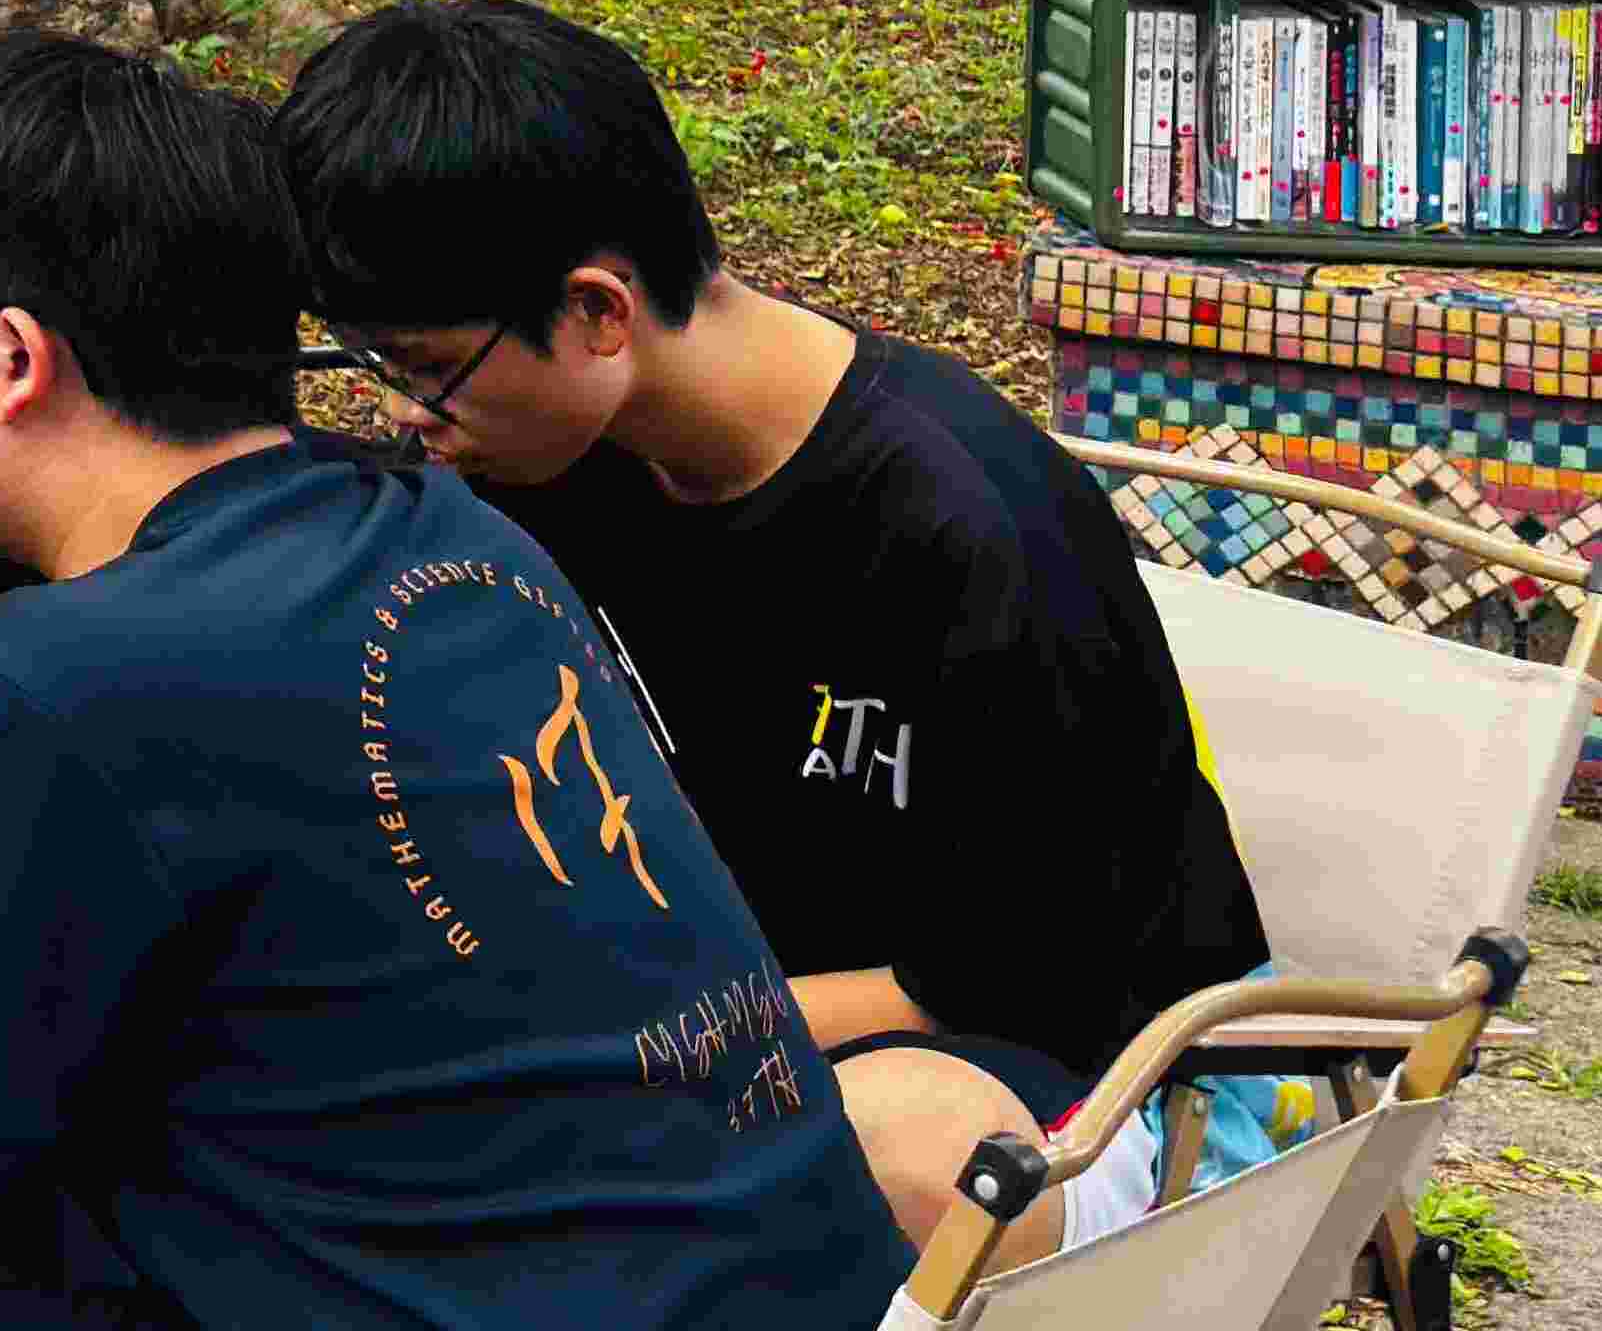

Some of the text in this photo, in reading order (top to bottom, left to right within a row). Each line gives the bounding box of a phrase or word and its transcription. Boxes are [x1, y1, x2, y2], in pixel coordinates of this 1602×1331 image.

[390, 559, 497, 606] SCIENCE
[375, 605, 400, 633] &
[359, 637, 481, 957] MATHEMATICS
